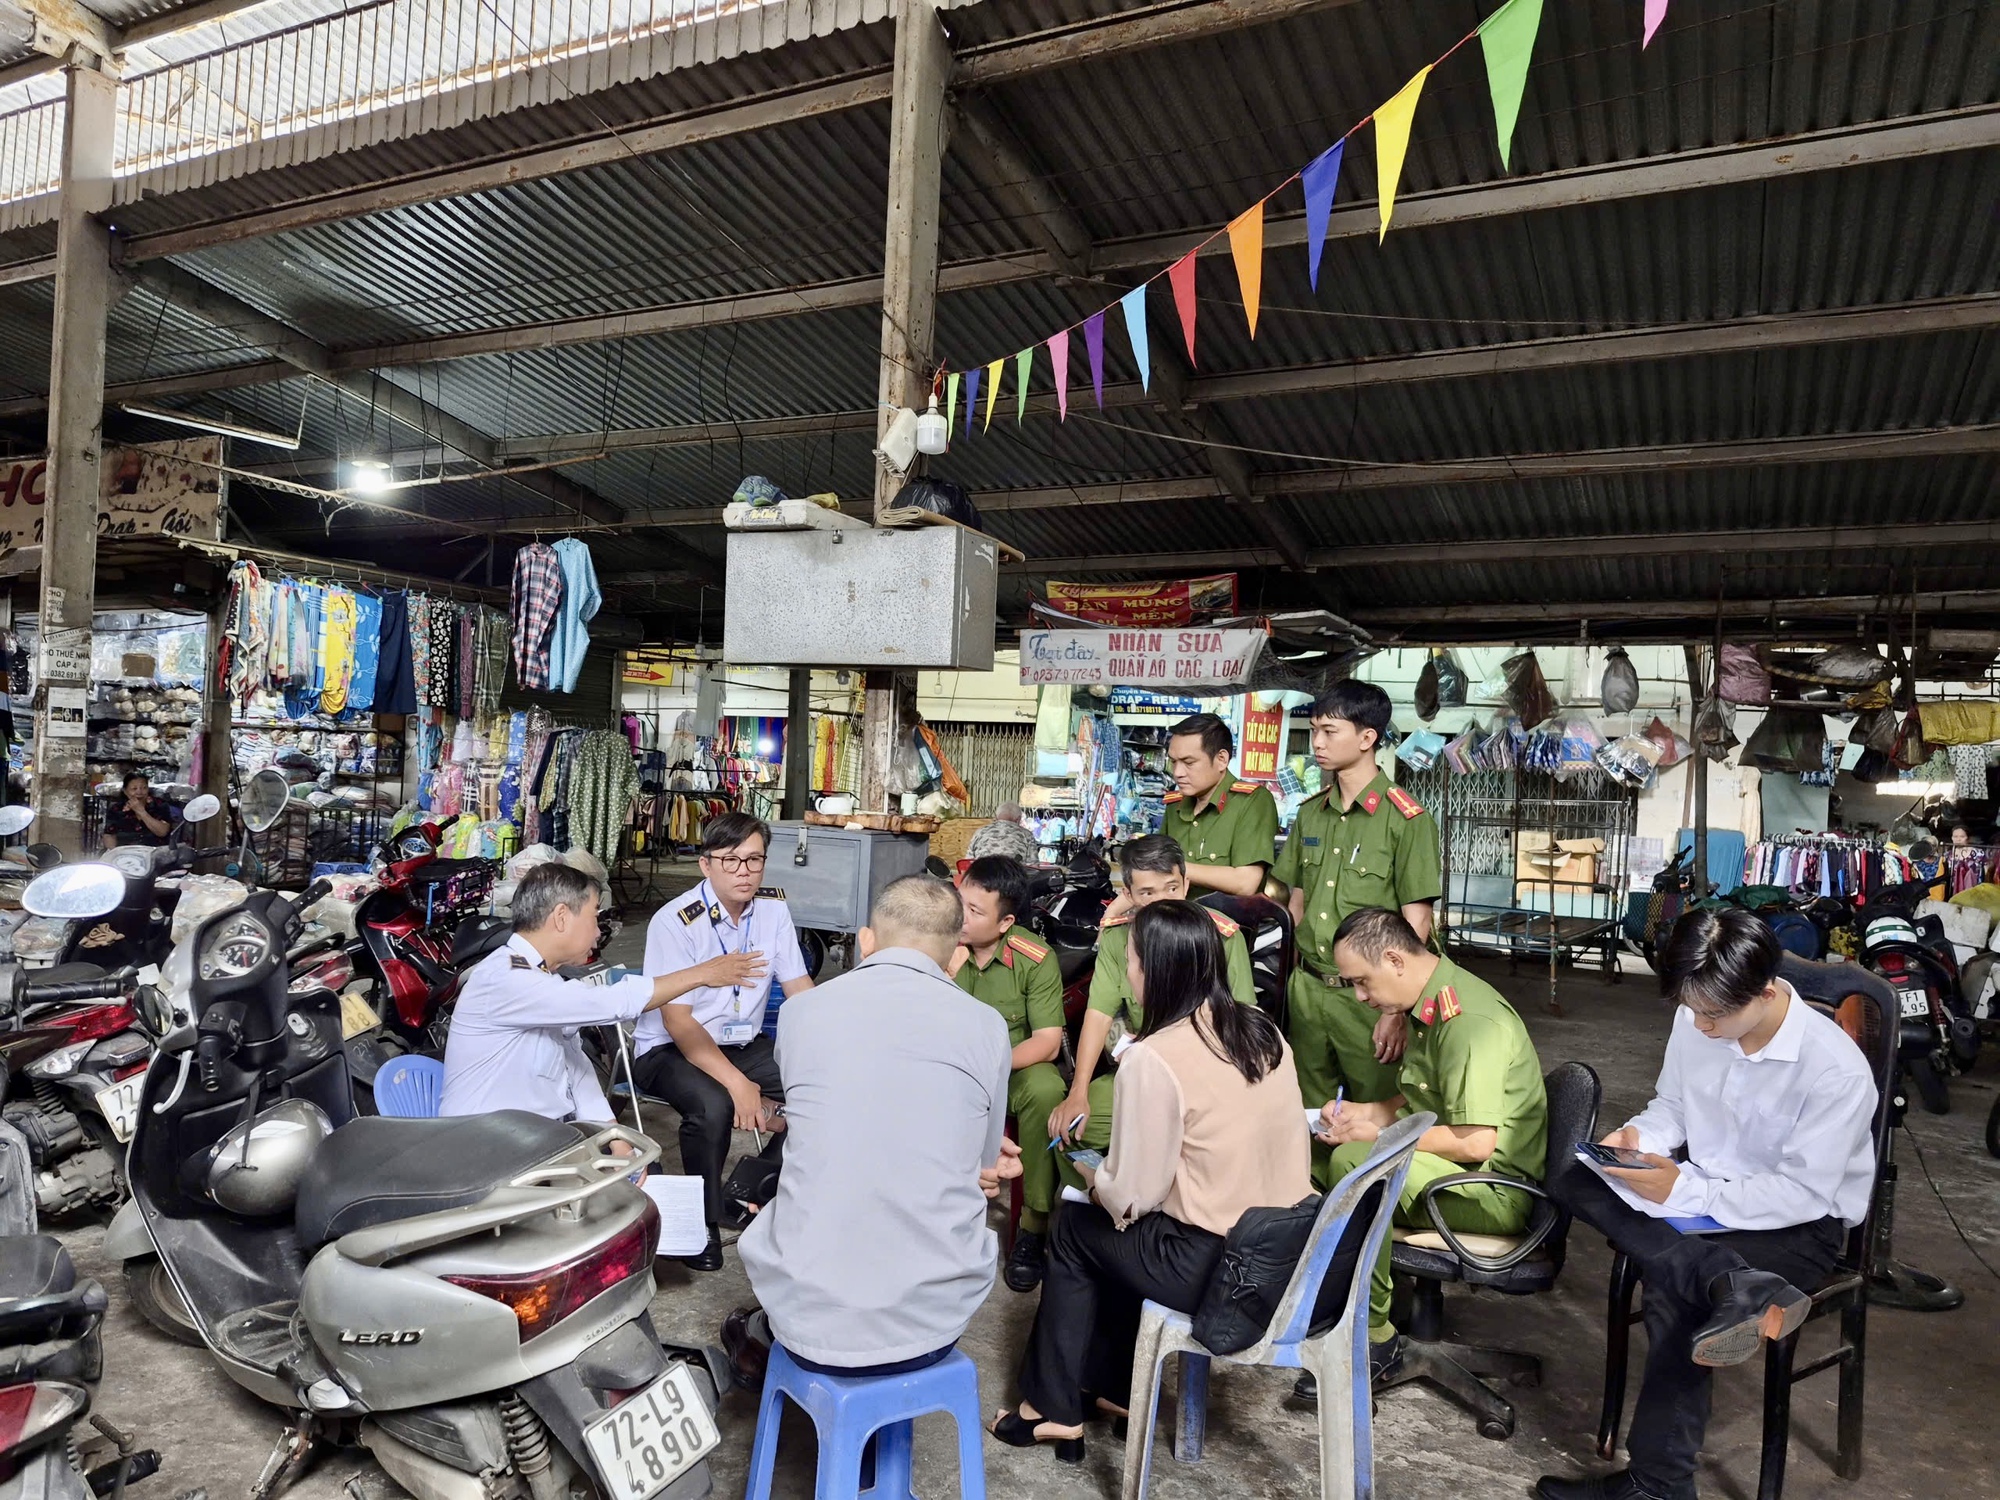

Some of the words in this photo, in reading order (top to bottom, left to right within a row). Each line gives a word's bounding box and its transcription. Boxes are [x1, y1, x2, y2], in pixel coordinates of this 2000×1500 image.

[1111, 695, 1143, 704] DRAP
[1152, 696, 1180, 705] REM
[338, 1328, 425, 1346] LEAD
[602, 1379, 684, 1460] 72-L9
[625, 1416, 702, 1494] 4890
